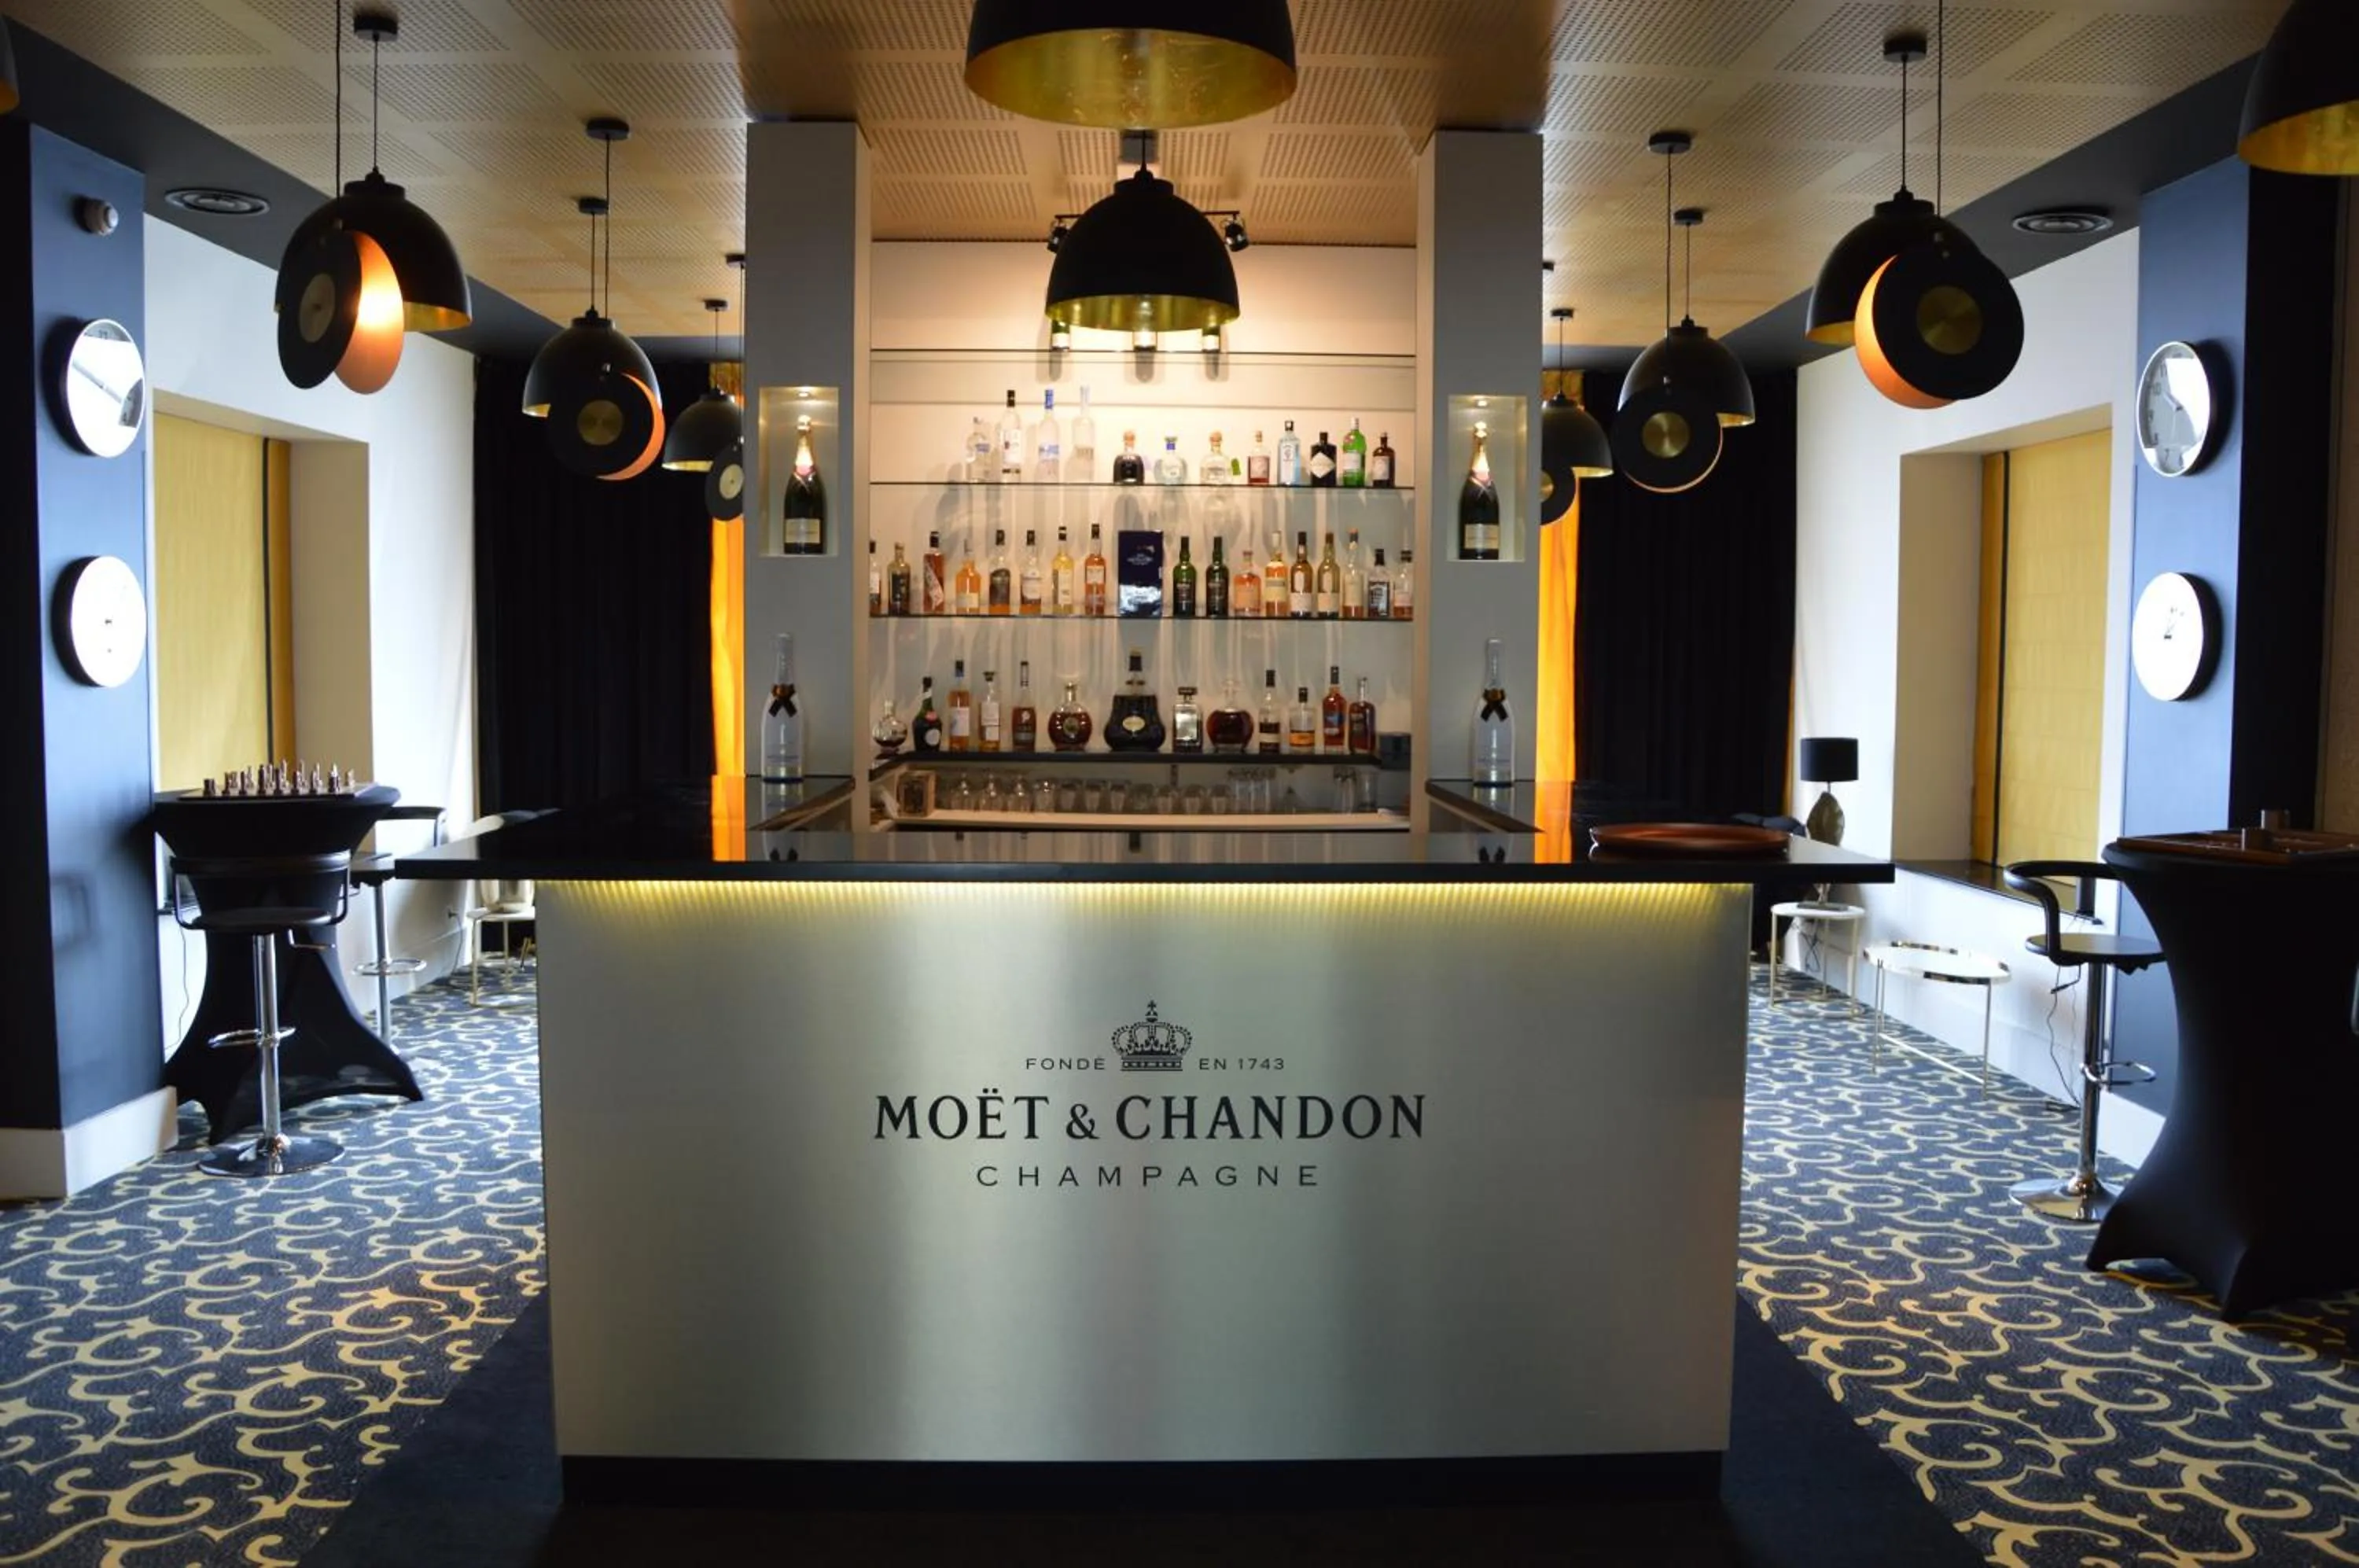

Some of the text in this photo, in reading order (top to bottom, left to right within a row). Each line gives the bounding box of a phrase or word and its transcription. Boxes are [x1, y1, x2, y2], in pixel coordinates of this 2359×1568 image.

[1199, 1058, 1227, 1070] EN
[1238, 1058, 1284, 1070] 1743
[874, 1088, 1426, 1140] MOËT & CHANDON
[977, 1165, 1318, 1187] CHAMPAGNE
